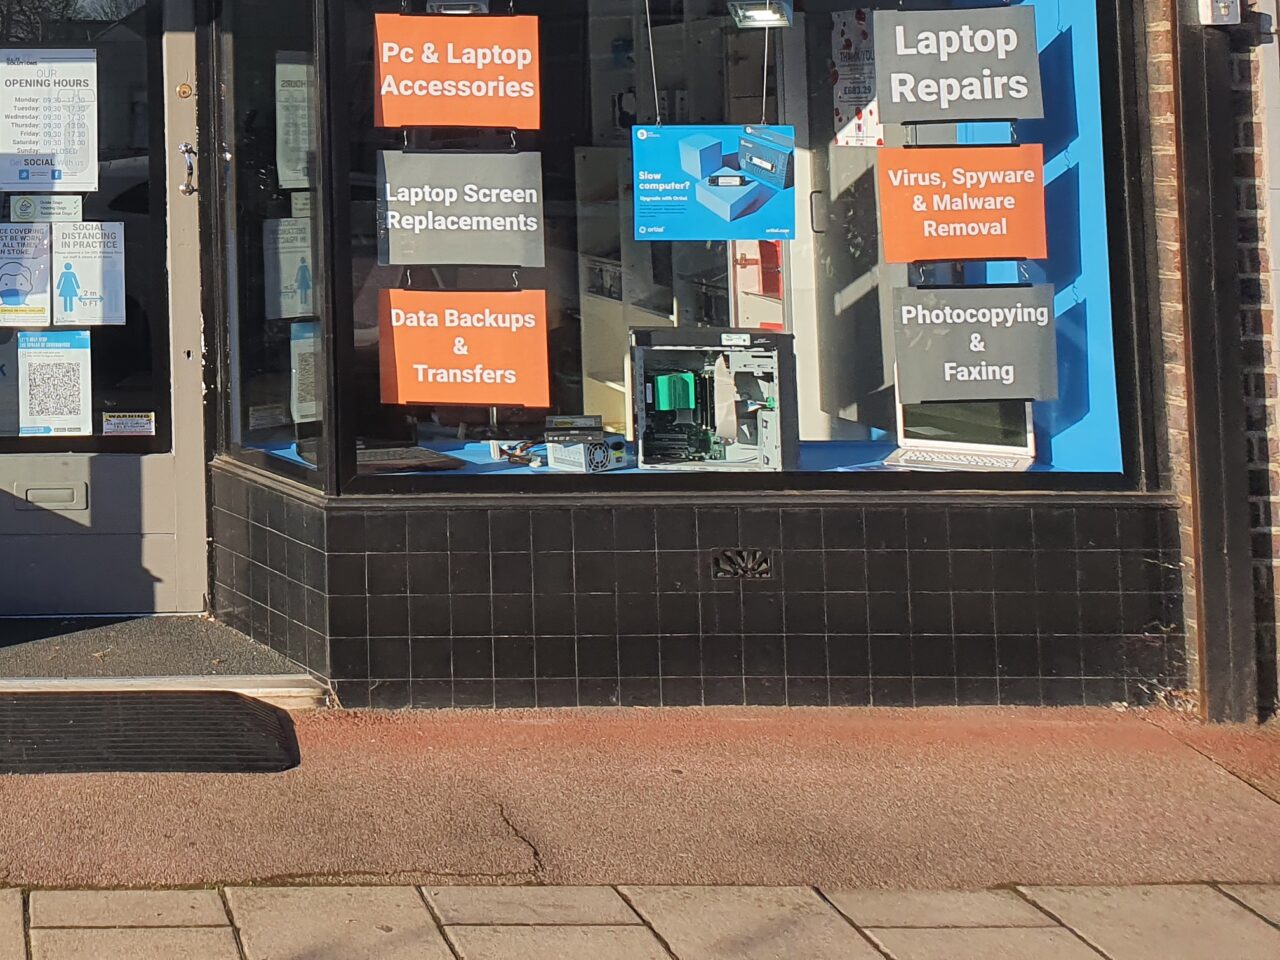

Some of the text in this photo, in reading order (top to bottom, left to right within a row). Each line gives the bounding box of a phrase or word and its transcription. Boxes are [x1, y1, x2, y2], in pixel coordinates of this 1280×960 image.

[895, 24, 1018, 61] Laptop
[381, 42, 532, 69] Pc & Laptop
[4, 79, 89, 88] OPENING HOURS
[36, 69, 57, 78] OUR
[380, 74, 535, 98] Accessories
[890, 69, 1029, 108] Repairs
[639, 171, 662, 180] Slow
[887, 168, 1035, 189] Virus, Spyware
[386, 183, 537, 206] Laptop Screen
[639, 181, 690, 192] computer?
[912, 193, 1015, 212] & Malware
[386, 211, 538, 234] Replacements
[923, 218, 1007, 237] Removal
[391, 308, 536, 331] Data Backups
[901, 303, 1048, 327] Photocopying
[452, 336, 468, 355] &
[970, 333, 985, 352] &
[412, 363, 517, 384] Transfers
[944, 362, 1015, 385] Faxing
